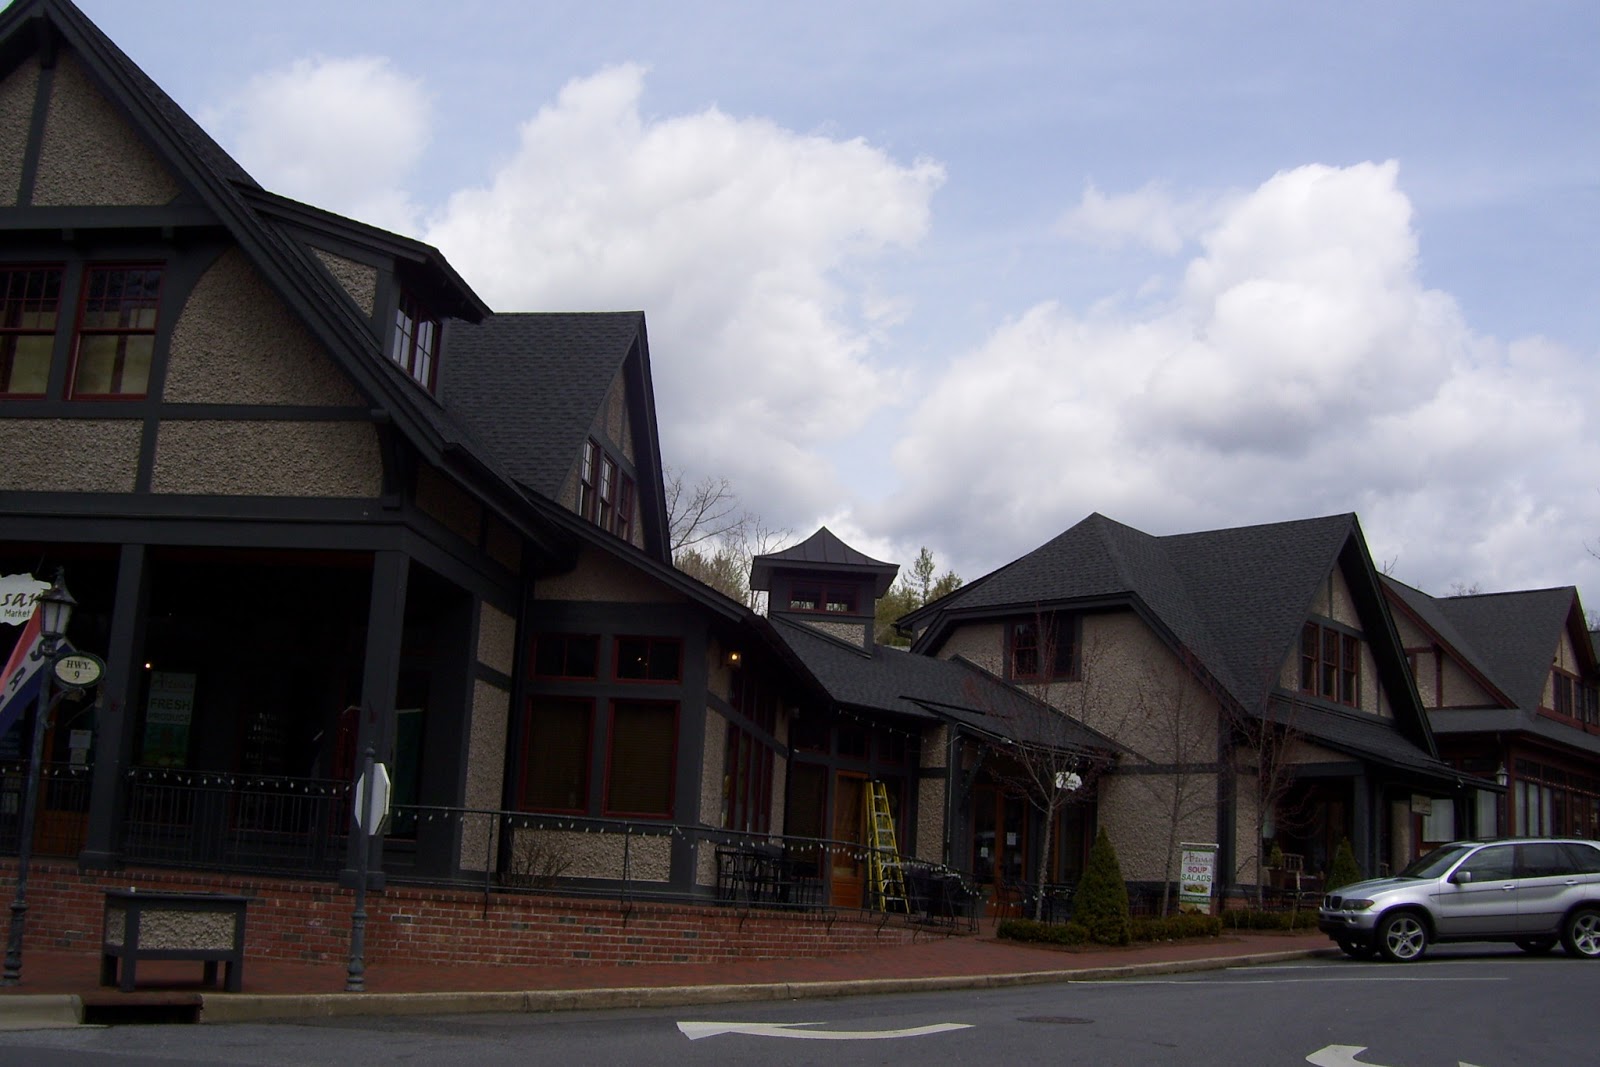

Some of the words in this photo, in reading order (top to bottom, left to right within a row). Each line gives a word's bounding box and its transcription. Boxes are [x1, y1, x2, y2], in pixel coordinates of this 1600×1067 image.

[4, 609, 30, 618] Market
[74, 670, 80, 680] 9
[150, 698, 191, 711] FRESH
[1181, 874, 1212, 882] SALADS
